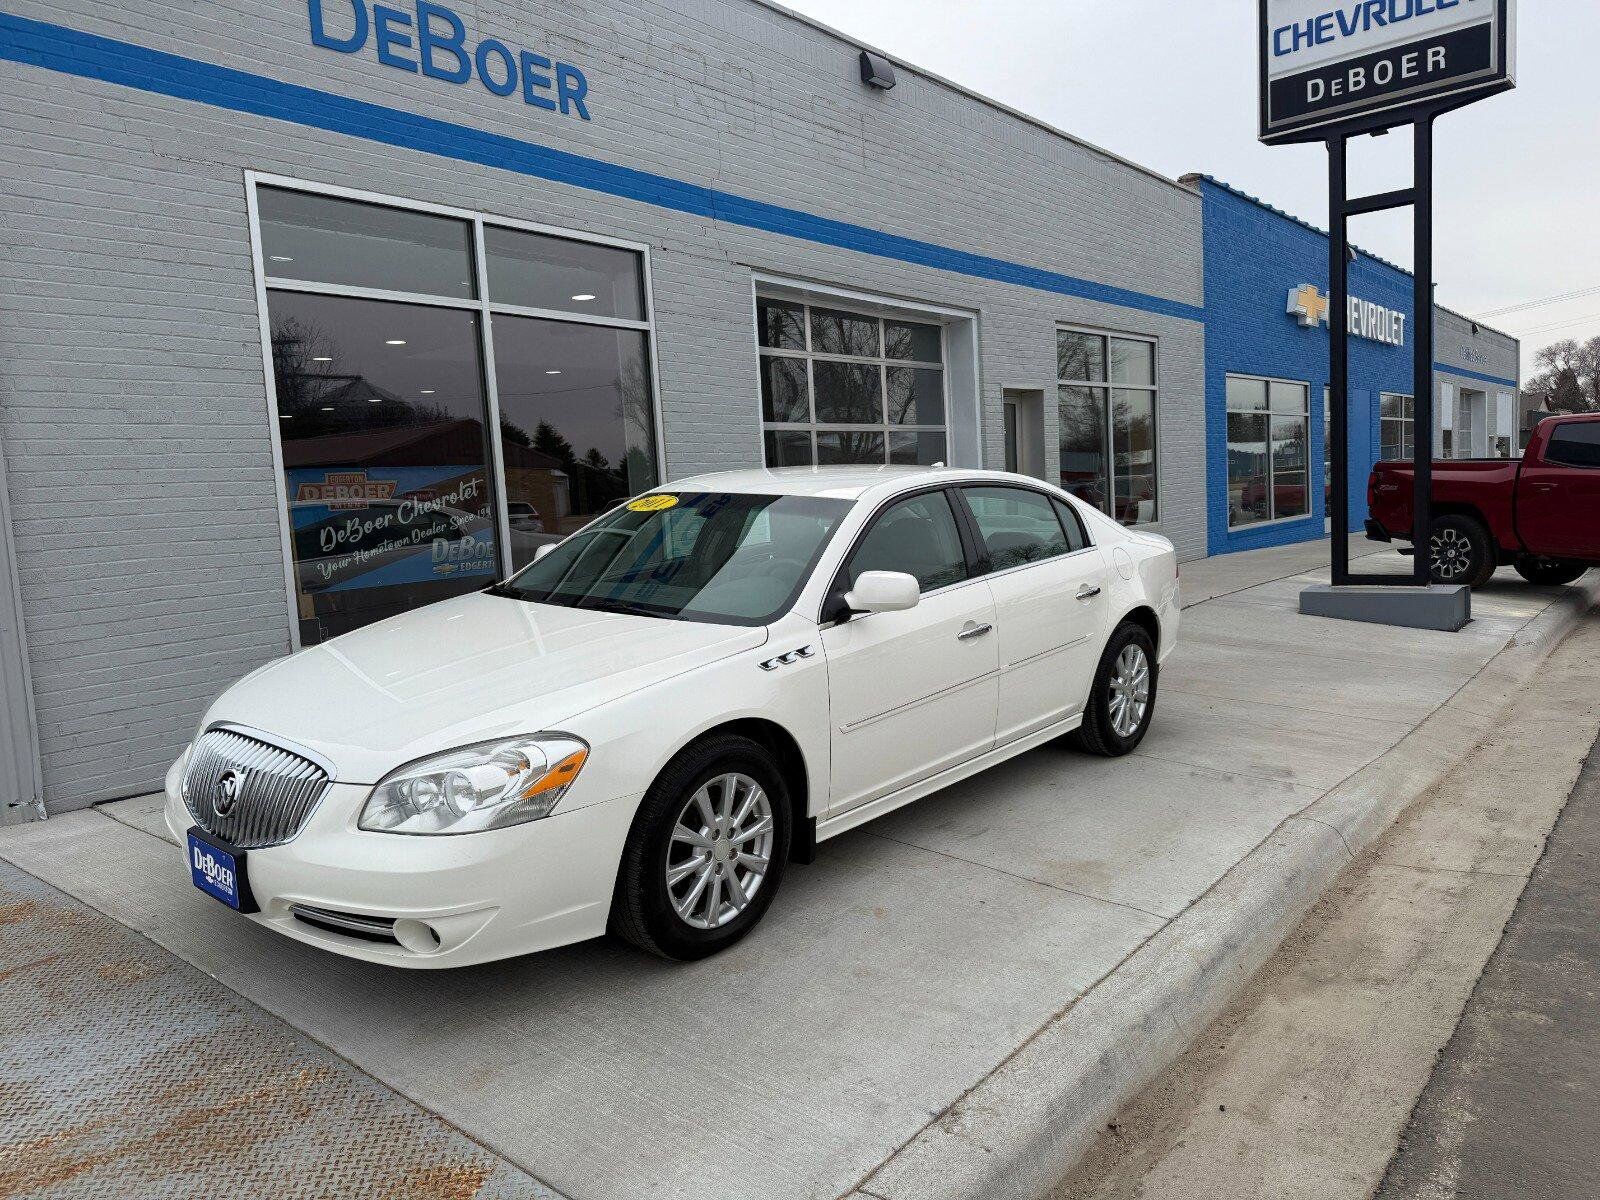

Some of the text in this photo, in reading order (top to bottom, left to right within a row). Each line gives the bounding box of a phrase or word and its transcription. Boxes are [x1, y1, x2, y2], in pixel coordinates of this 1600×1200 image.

[303, 484, 390, 500] DEBOER
[319, 479, 484, 551] DeBoer Chevrolet
[317, 557, 351, 580] Your
[353, 536, 410, 566] Hometown
[411, 522, 448, 546] Dealer
[450, 513, 475, 531] Since
[432, 535, 494, 563] DEBOE
